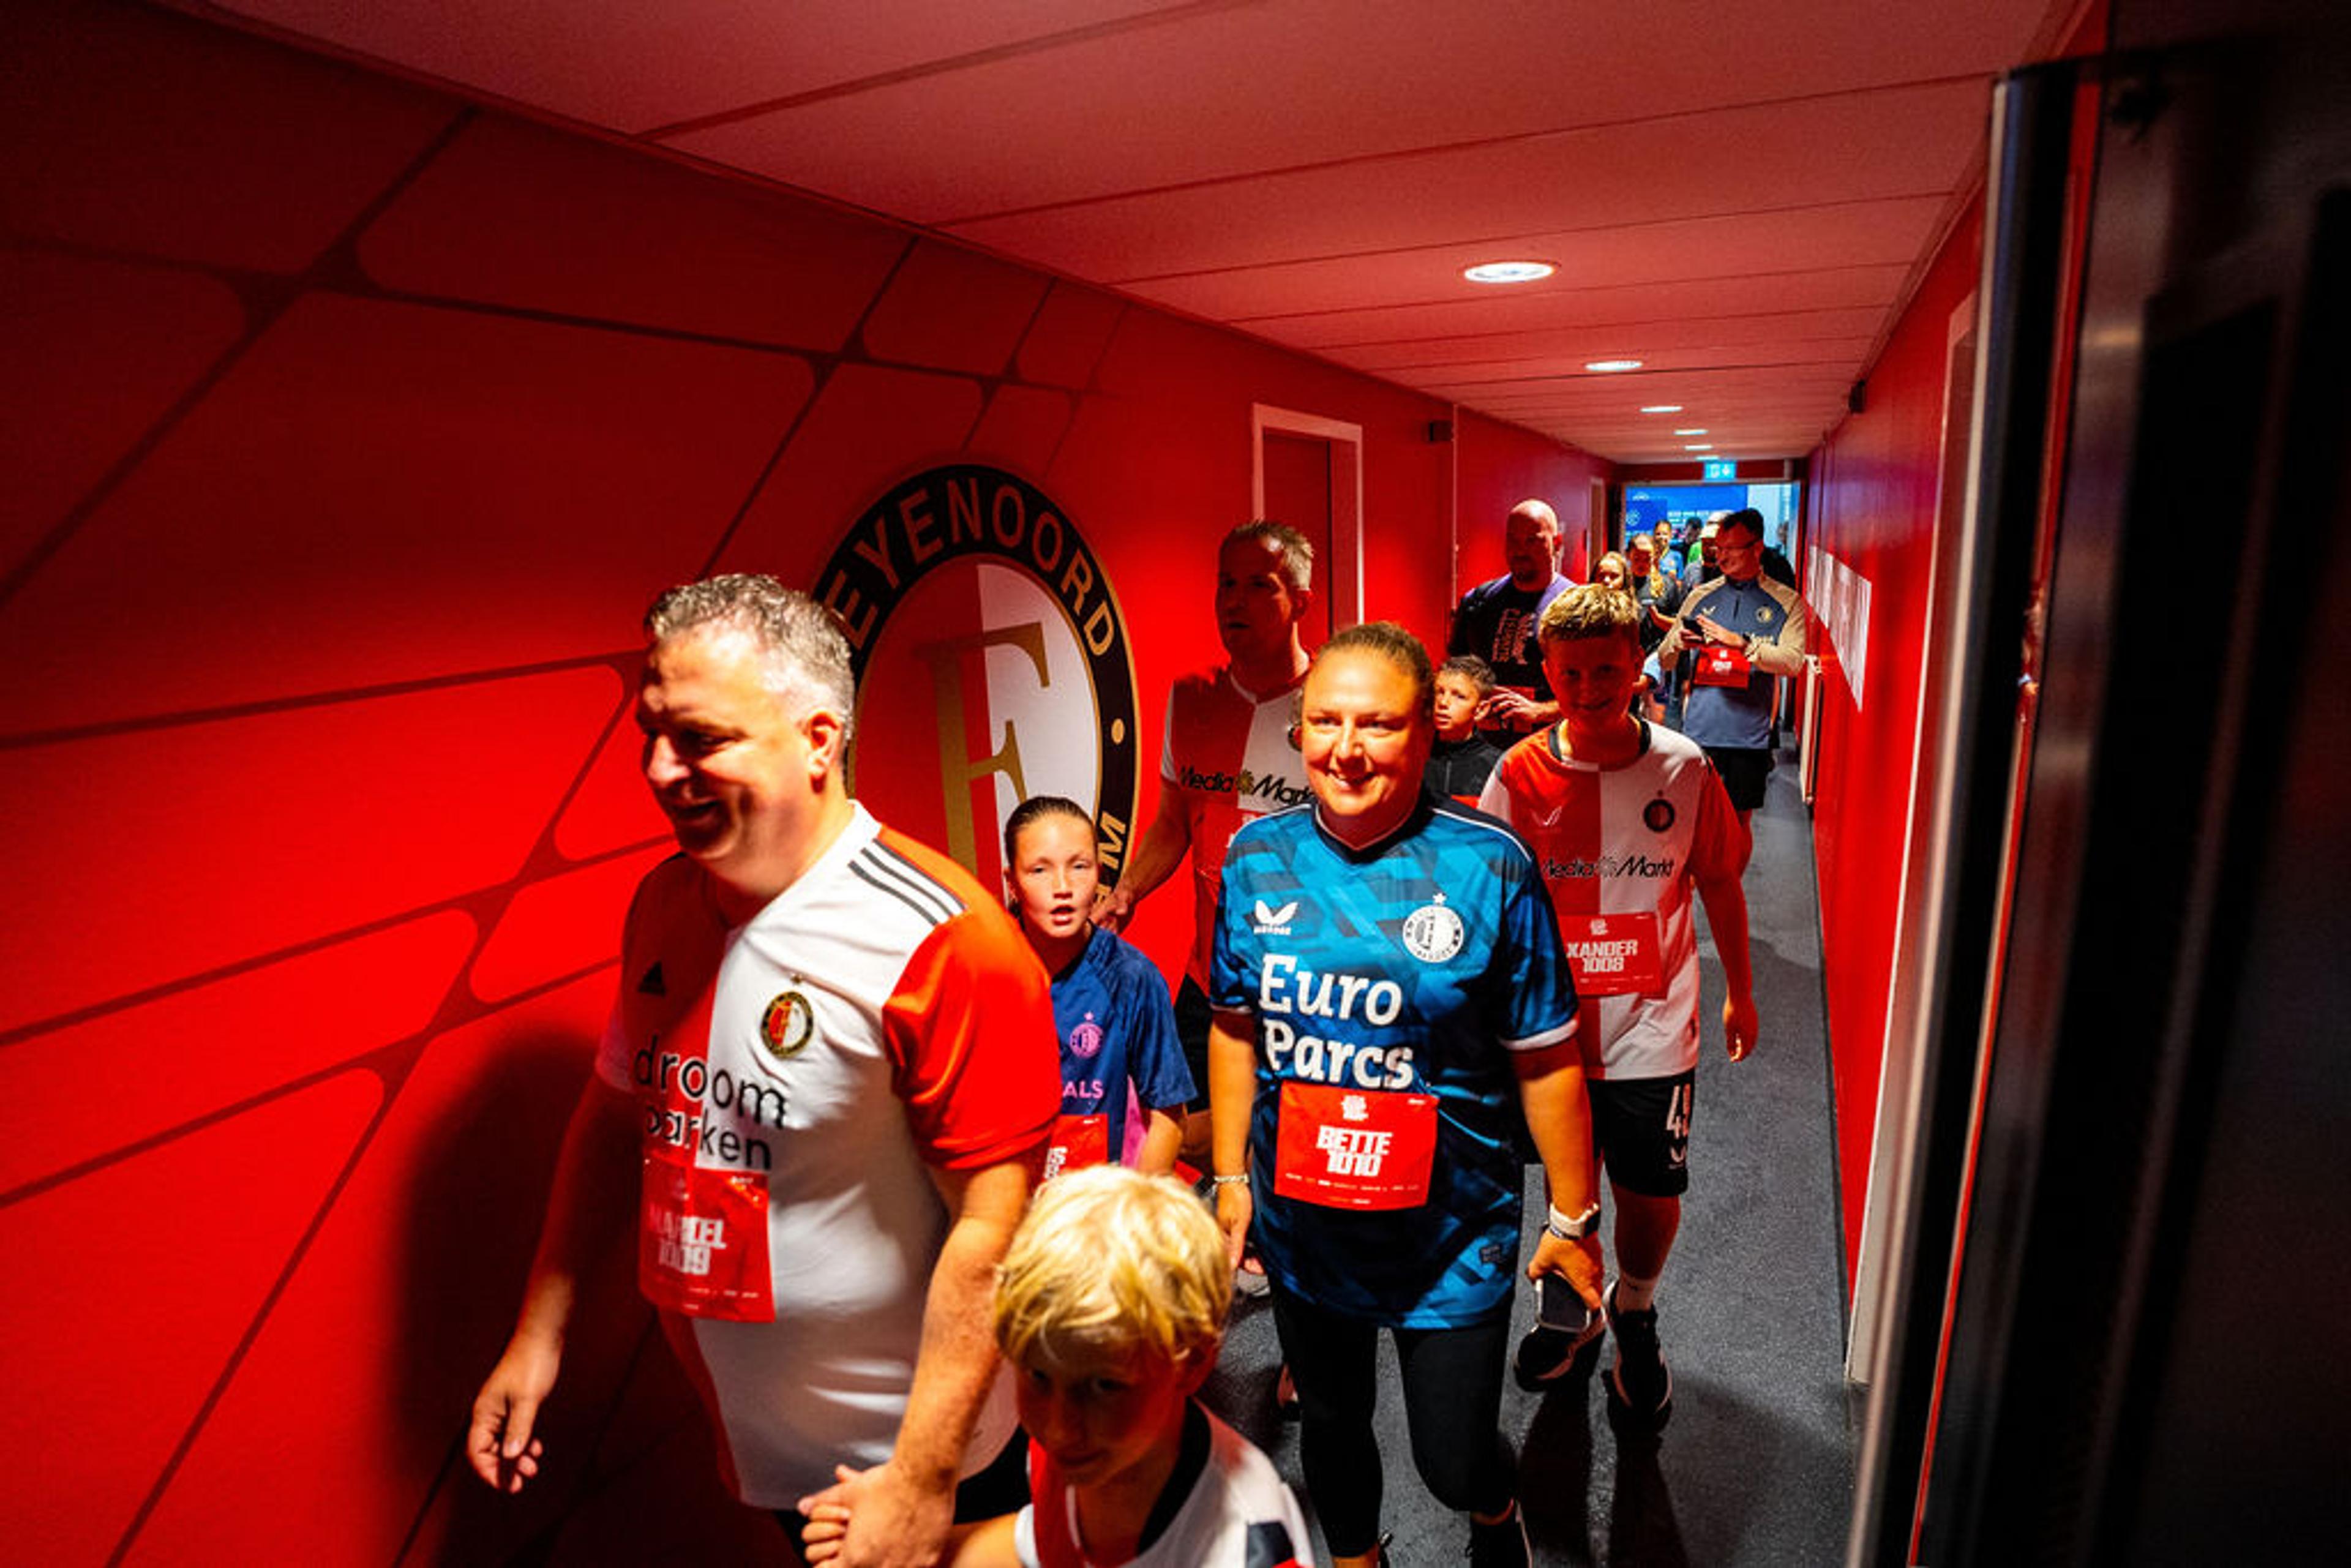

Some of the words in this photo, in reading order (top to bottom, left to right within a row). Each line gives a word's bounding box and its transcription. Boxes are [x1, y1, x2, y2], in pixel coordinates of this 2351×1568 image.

[823, 478, 1115, 656] EYENOORD
[1252, 773, 1315, 804] Mark
[1615, 855, 1674, 878] Markt
[1566, 939, 1638, 958] XANDER
[1582, 956, 1625, 973] 1008
[1259, 953, 1402, 1026] Euro
[1263, 1017, 1413, 1089] Parcs
[635, 1035, 785, 1130] droom
[1062, 1079, 1104, 1099] ALS
[1316, 1125, 1393, 1156] BETTE
[1327, 1149, 1382, 1177] 1010
